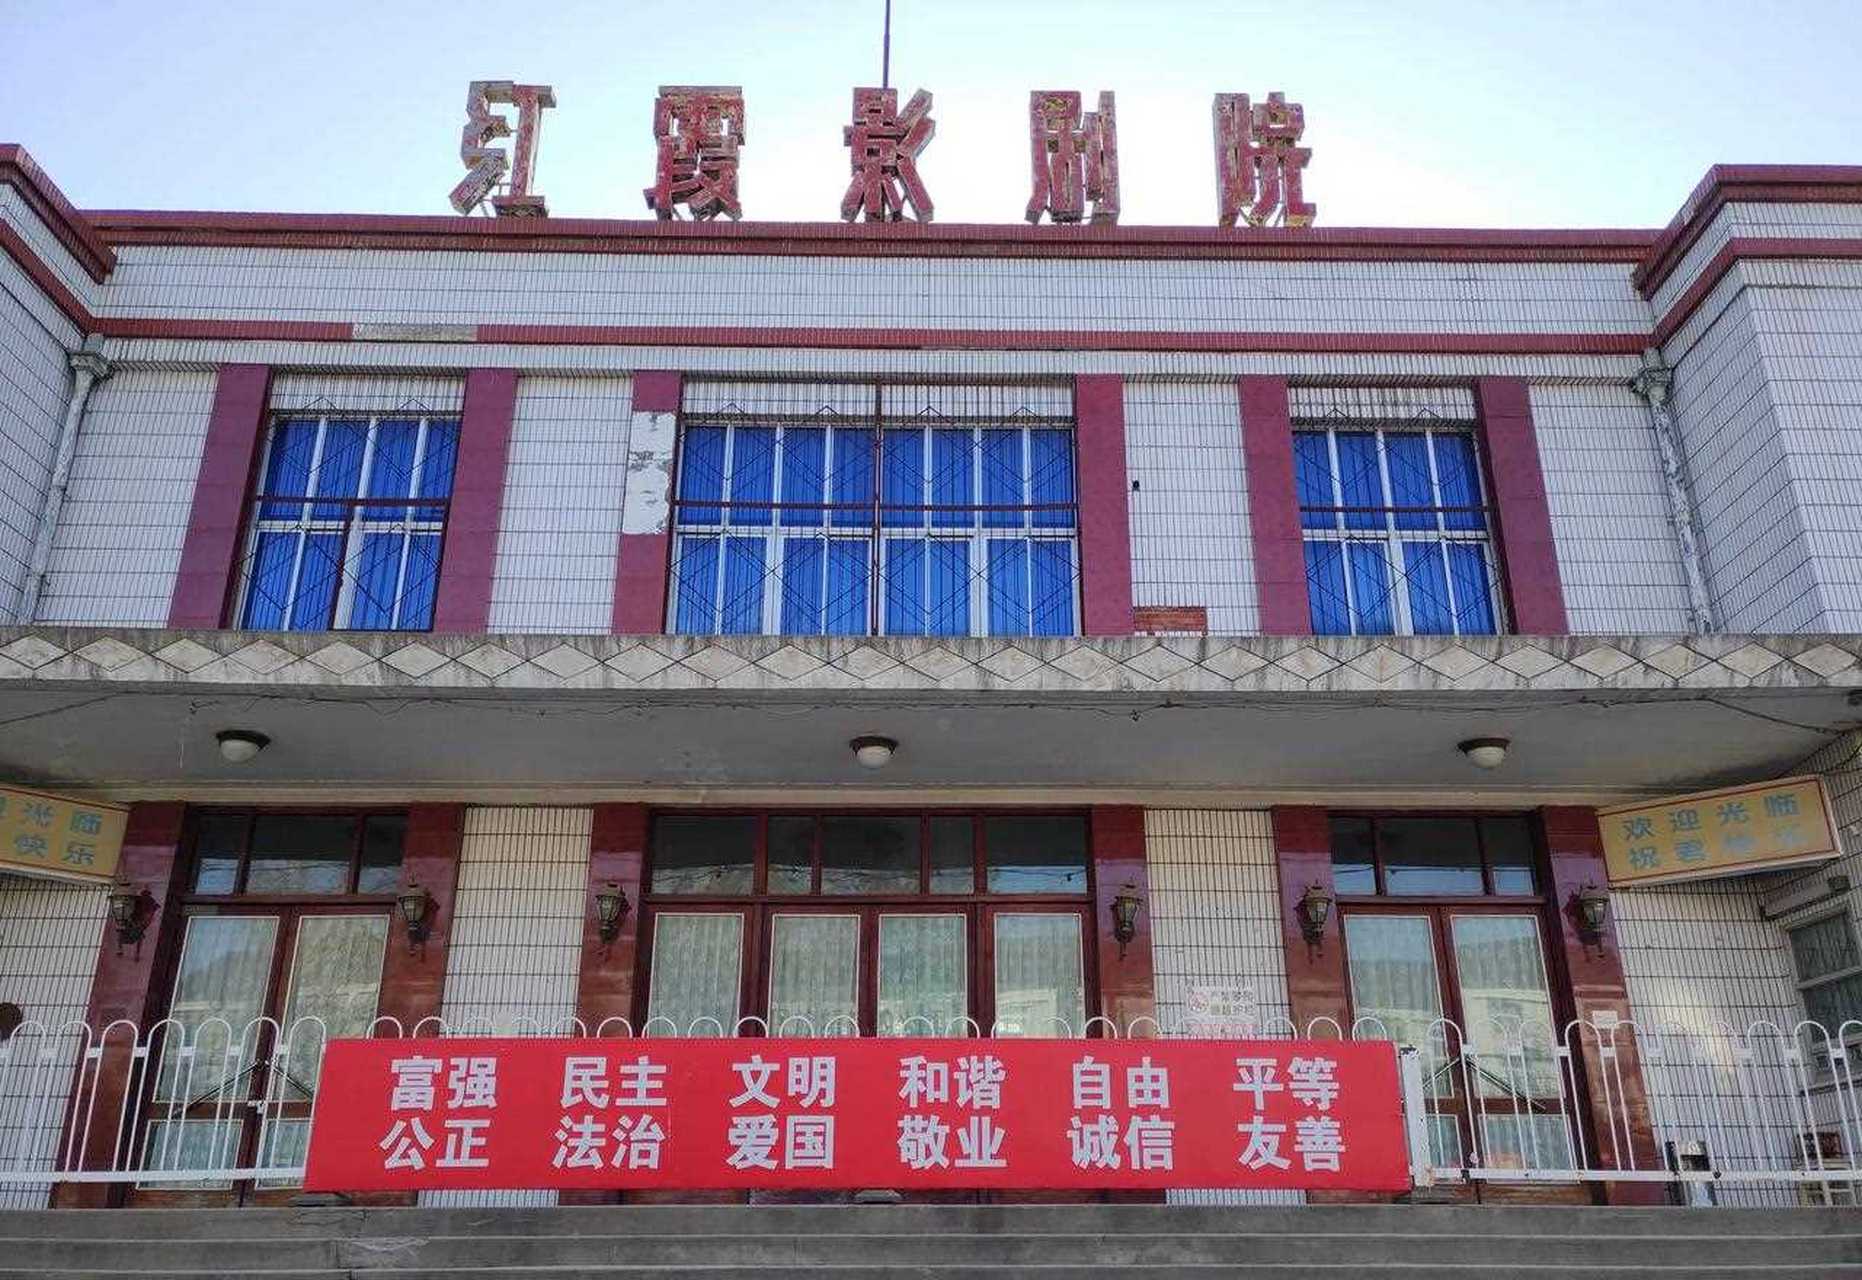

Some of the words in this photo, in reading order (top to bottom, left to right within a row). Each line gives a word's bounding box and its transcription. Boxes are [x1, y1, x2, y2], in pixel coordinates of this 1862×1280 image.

[449, 80, 1317, 229] 红霞影剧院
[0, 797, 103, 836] 光临
[1620, 792, 1799, 841] 欢迎光临
[390, 1055, 499, 1112] 富强
[560, 1055, 668, 1109] 民主
[728, 1055, 837, 1109] 文明
[898, 1055, 1007, 1110] 和谐
[1072, 1055, 1172, 1110] 自由
[1232, 1056, 1341, 1111] 平等
[379, 1117, 493, 1170] 公正
[551, 1115, 666, 1170] 法治
[726, 1115, 836, 1171] 爱国
[896, 1115, 1007, 1170] 敬业
[1066, 1115, 1176, 1170] 诚信
[1236, 1115, 1346, 1172] 友善
